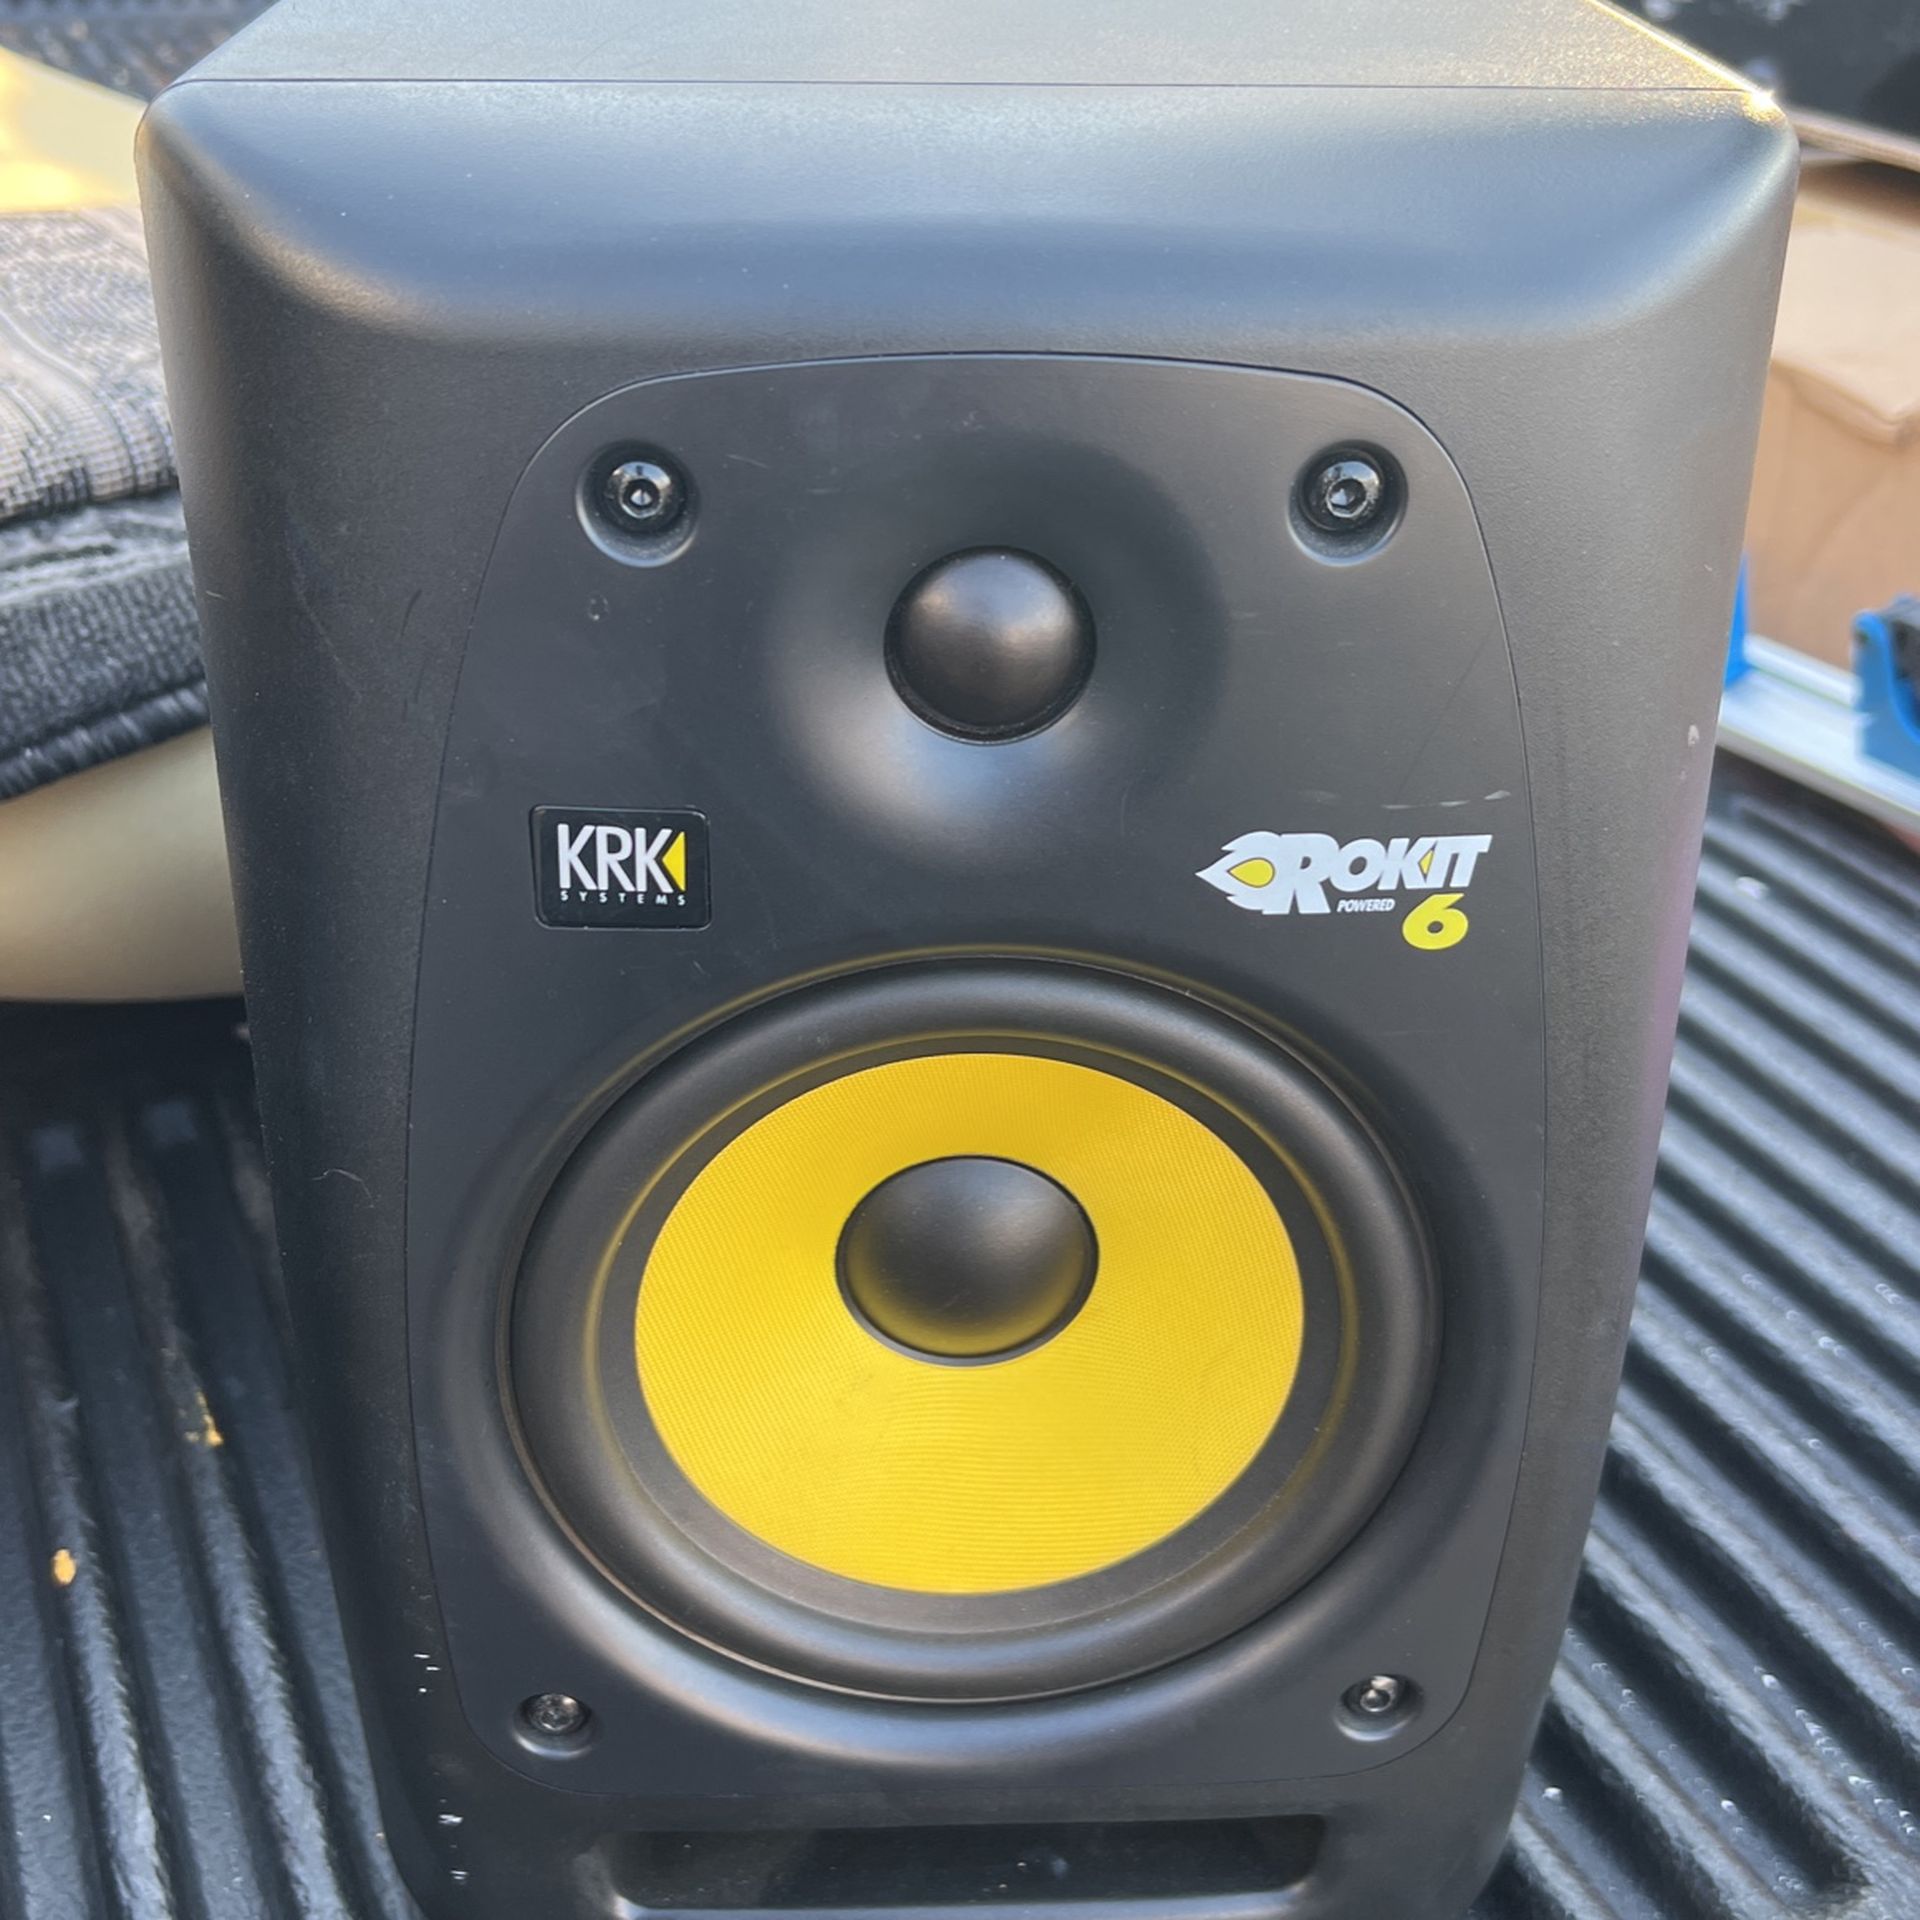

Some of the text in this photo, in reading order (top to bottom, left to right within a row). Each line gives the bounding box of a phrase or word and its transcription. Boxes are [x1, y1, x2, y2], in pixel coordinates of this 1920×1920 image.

[557, 823, 674, 894] KRK
[1261, 832, 1493, 915] ROKIT
[560, 890, 686, 906] SYSTEMS
[1336, 898, 1396, 912] POWERED
[1402, 893, 1469, 950] 6
